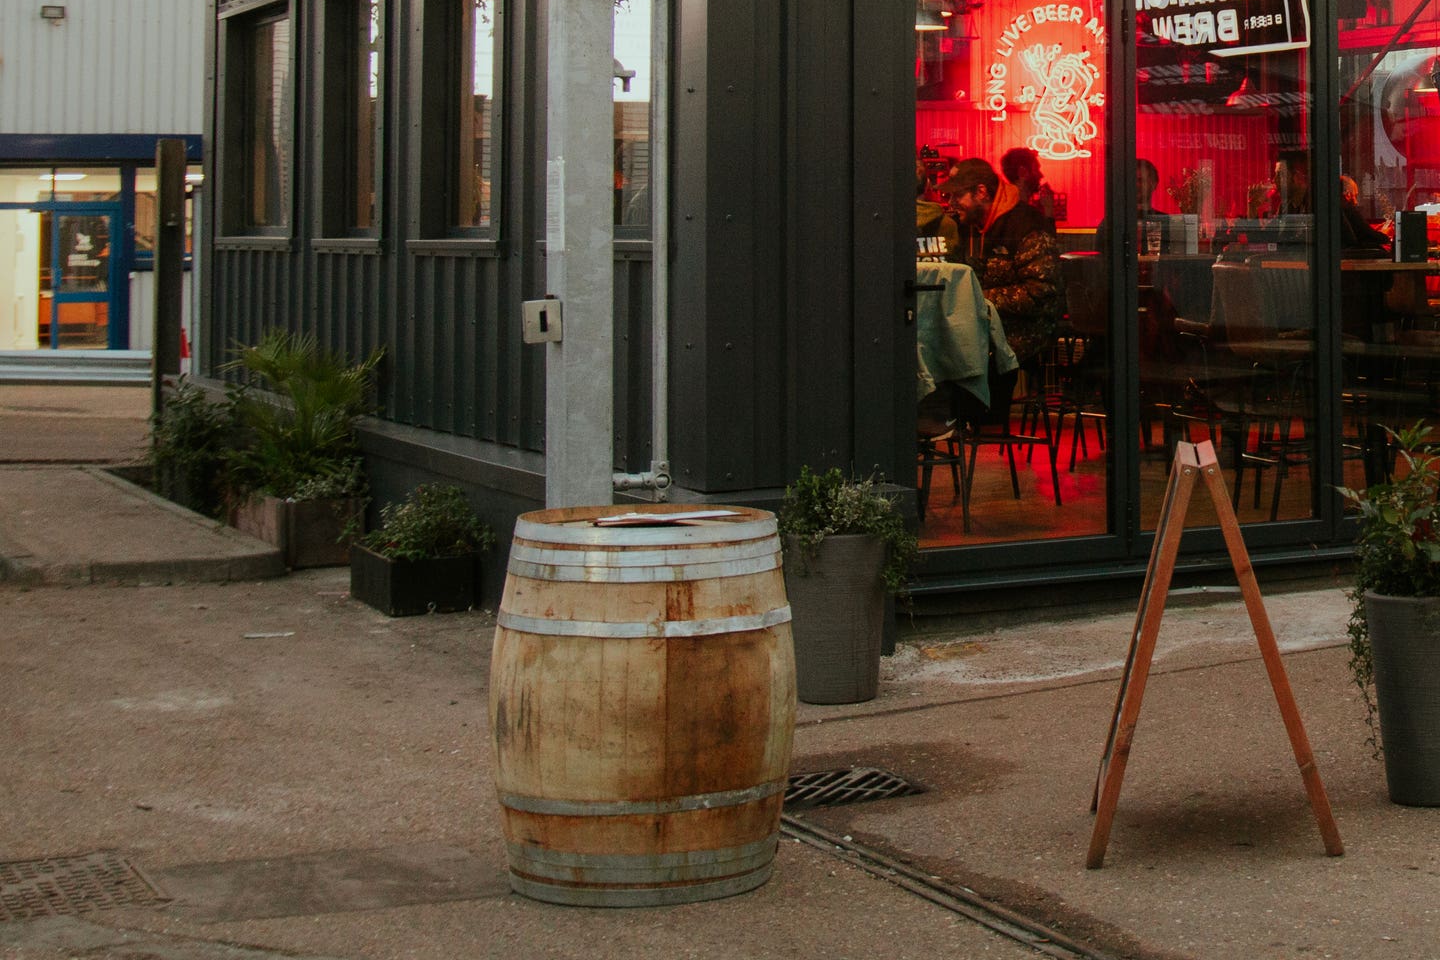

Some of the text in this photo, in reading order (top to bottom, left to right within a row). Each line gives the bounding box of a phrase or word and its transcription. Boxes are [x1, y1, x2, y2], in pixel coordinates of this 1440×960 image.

[1033, 4, 1083, 24] BEER
[996, 14, 1032, 57] LIVE
[989, 62, 1007, 122] LONG
[915, 236, 948, 254] THE
